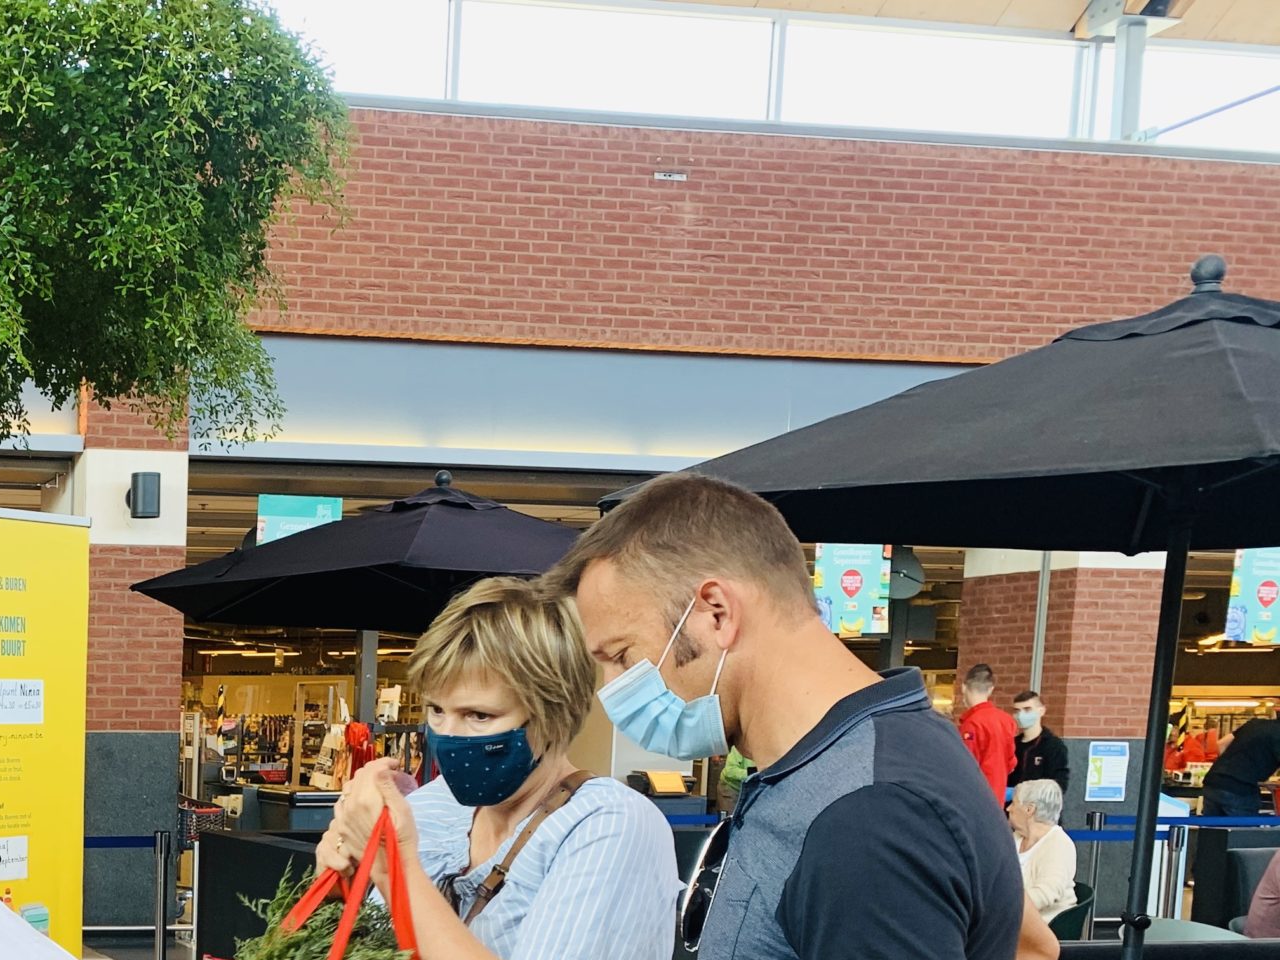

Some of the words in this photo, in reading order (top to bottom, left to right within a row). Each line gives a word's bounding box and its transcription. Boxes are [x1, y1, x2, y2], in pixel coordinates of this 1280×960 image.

[0, 576, 4, 590] &
[5, 577, 27, 592] BUREN
[0, 615, 26, 633] KOMEN
[1, 639, 26, 657] BUURT
